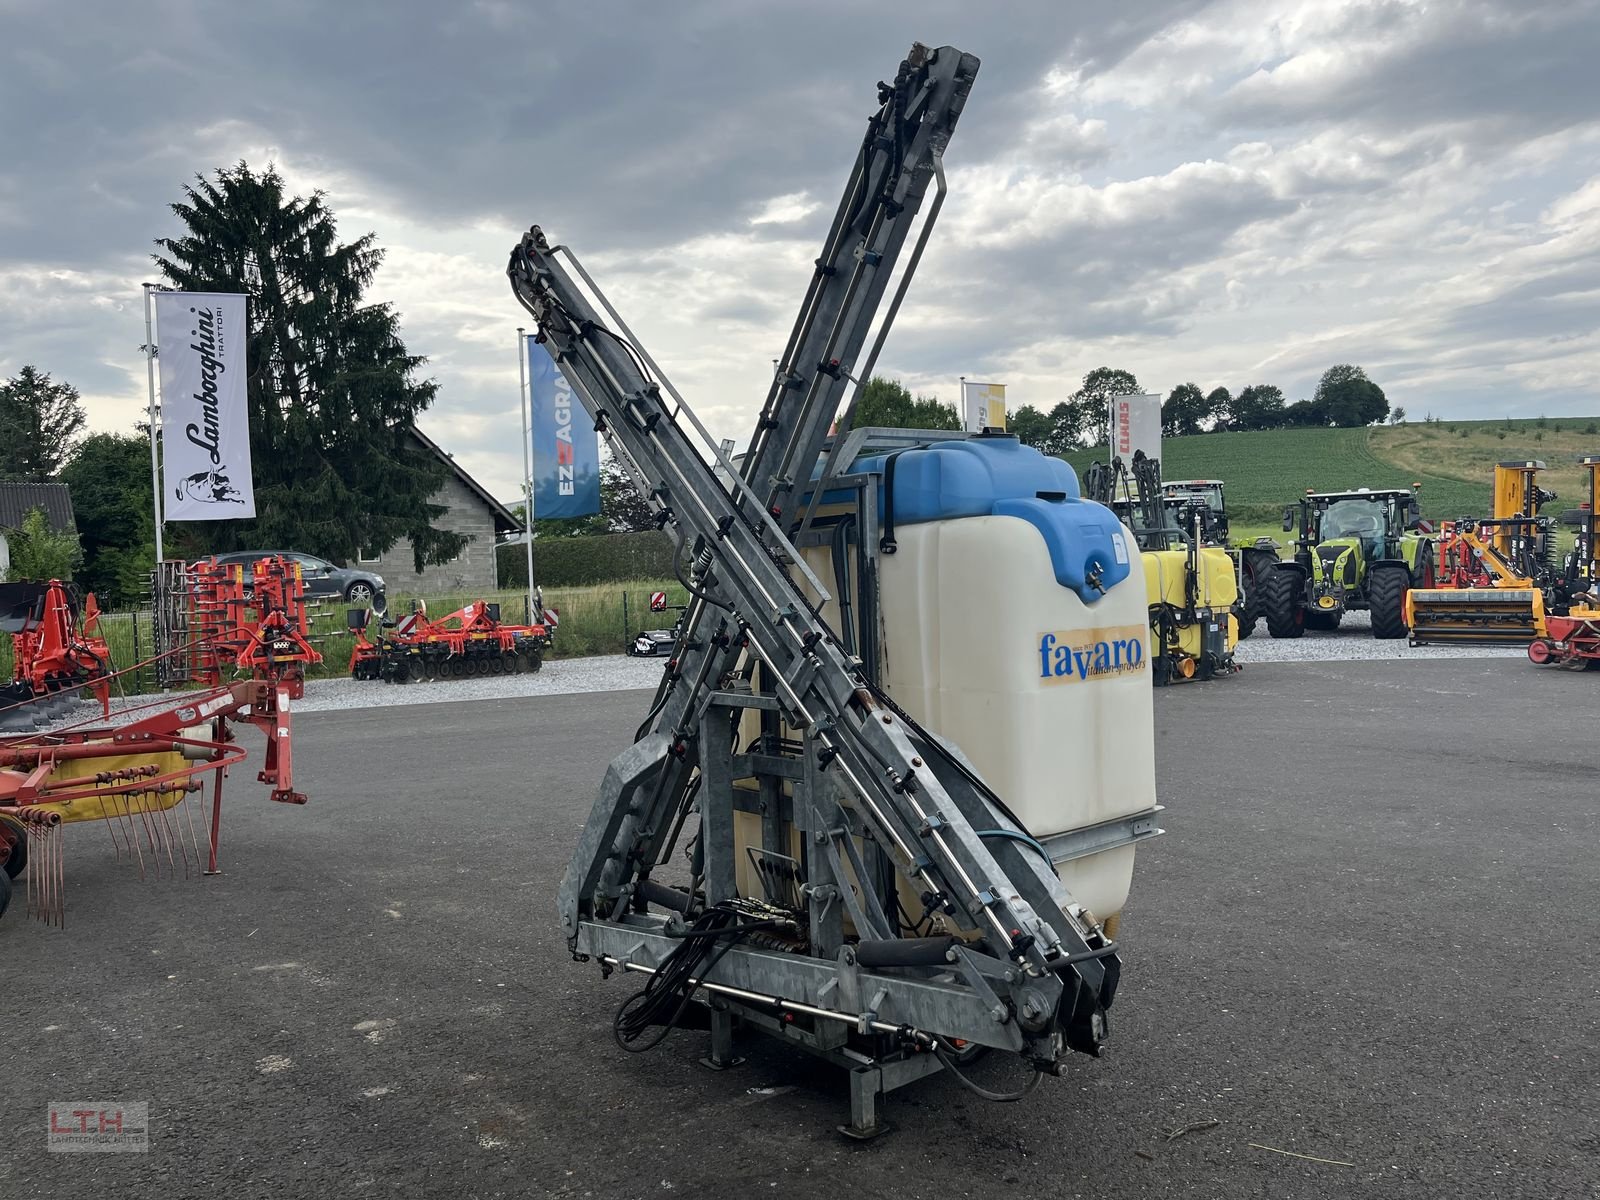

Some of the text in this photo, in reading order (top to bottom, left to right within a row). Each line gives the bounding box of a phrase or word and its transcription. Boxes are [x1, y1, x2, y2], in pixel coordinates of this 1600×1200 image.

[216, 307, 225, 358] TRATTORI
[185, 307, 225, 465] Lamborghini
[554, 362, 573, 444] AGRA
[1119, 402, 1130, 454] CLAAS
[1038, 633, 1142, 680] favaro
[1087, 659, 1146, 676] italian sprayers
